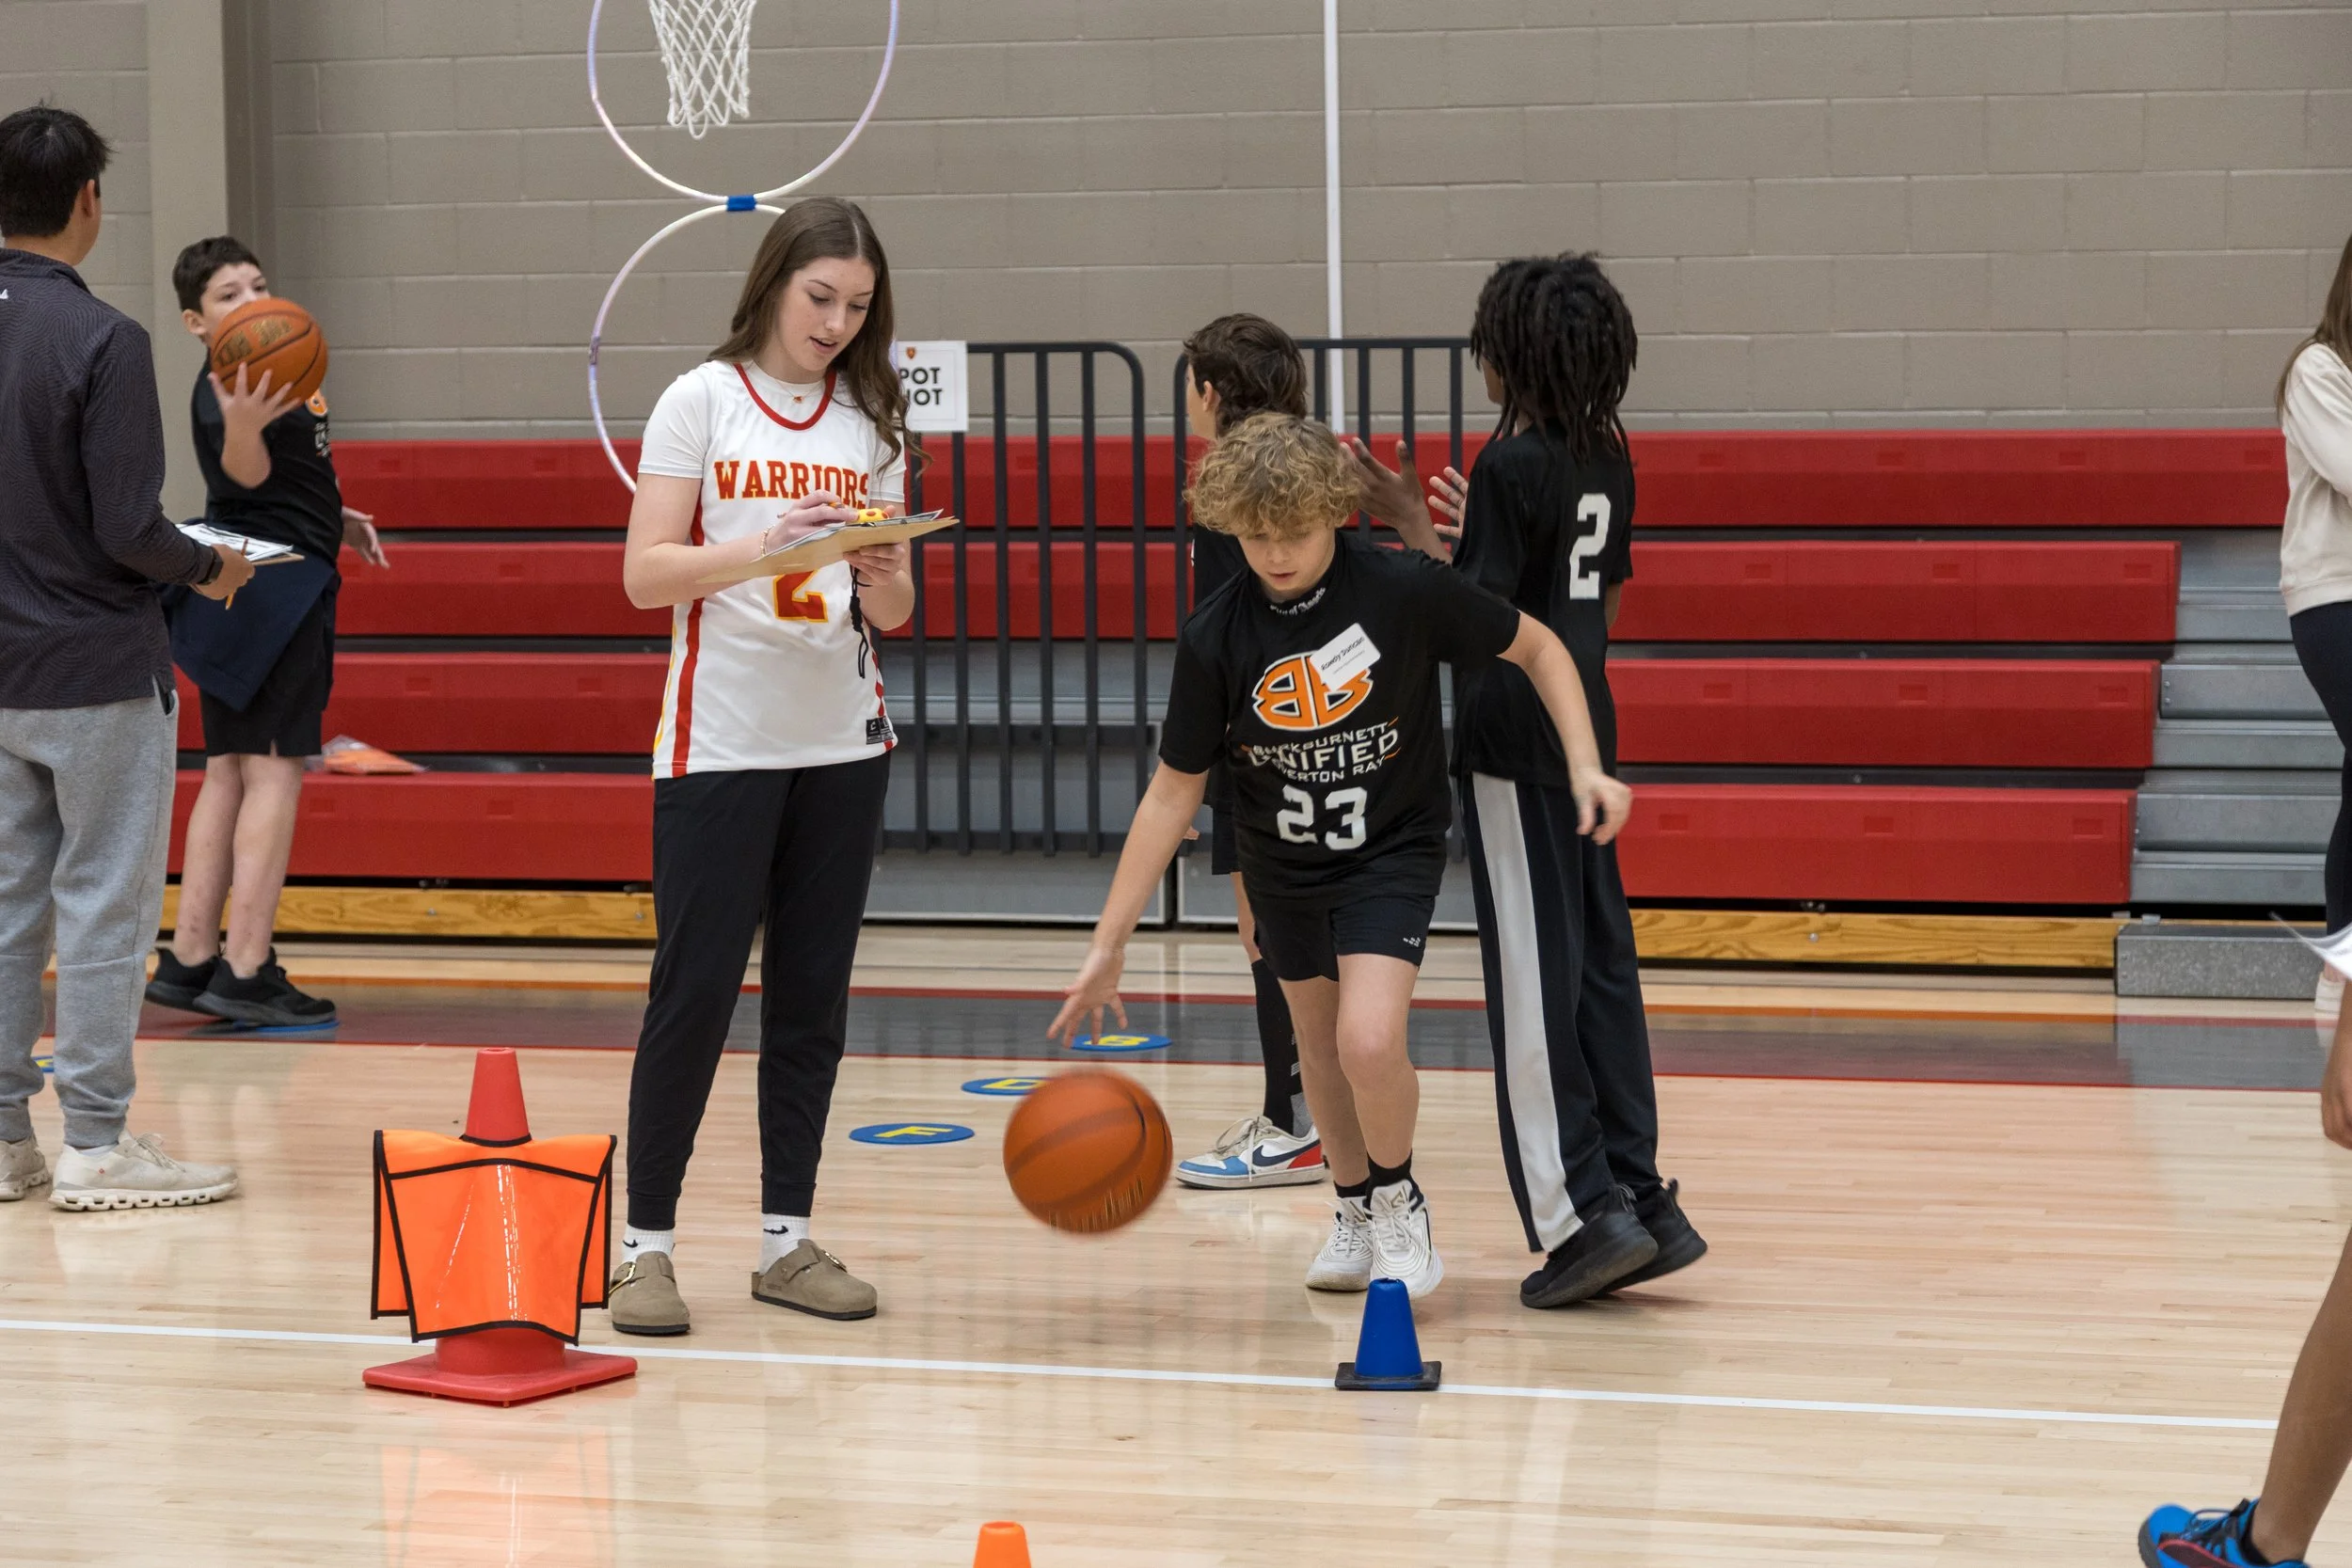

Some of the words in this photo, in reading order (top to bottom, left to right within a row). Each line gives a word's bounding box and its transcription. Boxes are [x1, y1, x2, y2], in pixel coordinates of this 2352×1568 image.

[898, 367, 941, 385] POT
[907, 388, 943, 405] OT
[713, 460, 869, 510] WARRIORS
[1569, 493, 1611, 600] 2
[1353, 755, 1386, 776] RAY
[1277, 784, 1368, 850] 23
[873, 1126, 954, 1138] F
